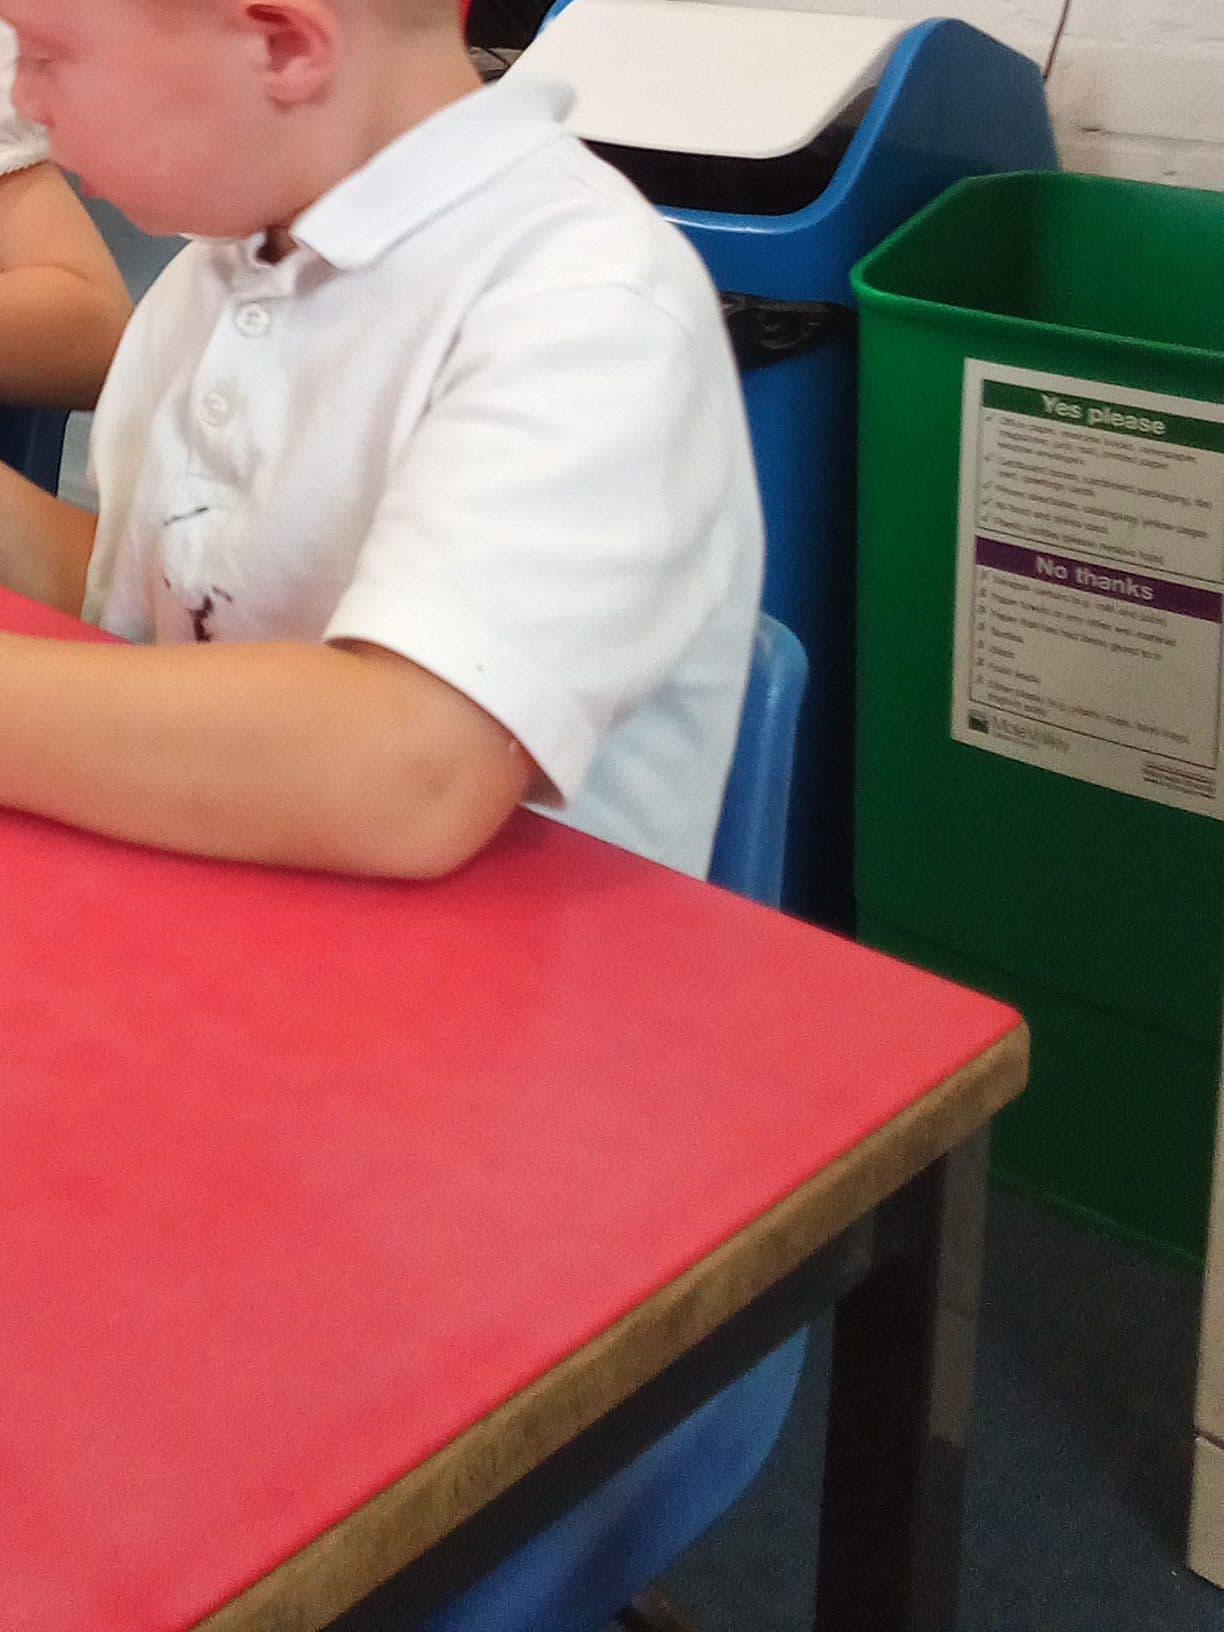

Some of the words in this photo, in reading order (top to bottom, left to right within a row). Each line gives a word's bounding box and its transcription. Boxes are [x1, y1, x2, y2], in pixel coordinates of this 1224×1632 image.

[1041, 394, 1082, 419] Yes
[1088, 406, 1167, 436] please
[1035, 556, 1068, 580] No
[1076, 568, 1154, 601] thanks
